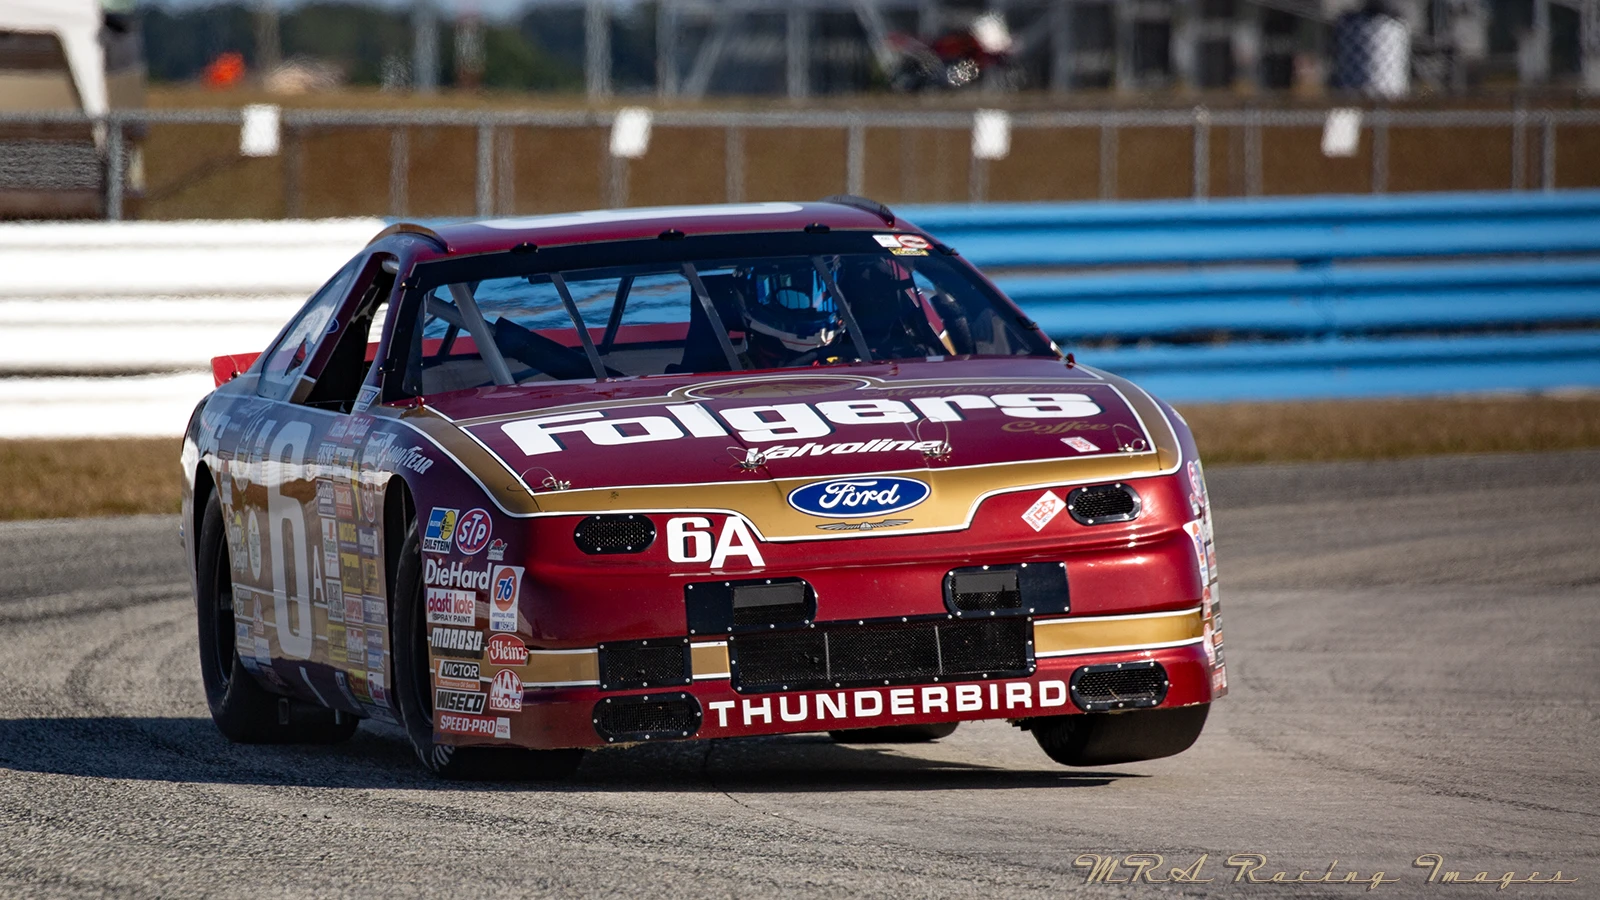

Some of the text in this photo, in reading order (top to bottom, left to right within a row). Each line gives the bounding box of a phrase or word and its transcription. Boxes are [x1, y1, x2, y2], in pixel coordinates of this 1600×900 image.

[501, 393, 1103, 457] Folgers
[1001, 420, 1110, 434] Coffee
[745, 438, 943, 463] Valvoline
[819, 481, 901, 509] Ford
[458, 513, 485, 547] STP
[423, 538, 451, 552] BILSTEIN
[667, 516, 766, 569] 6A
[425, 558, 492, 590] DieHard
[496, 576, 515, 601] 76
[428, 591, 474, 615] plasti kote
[433, 612, 471, 623] SPRAY PAINT
[431, 627, 483, 651] MOROSO
[490, 640, 527, 660] Heinz
[443, 663, 479, 679] VICTOR
[492, 671, 521, 698] MAC
[436, 690, 485, 713] WISECO
[491, 697, 521, 709] TOOLS
[709, 680, 1066, 728] THUNDERBIRD
